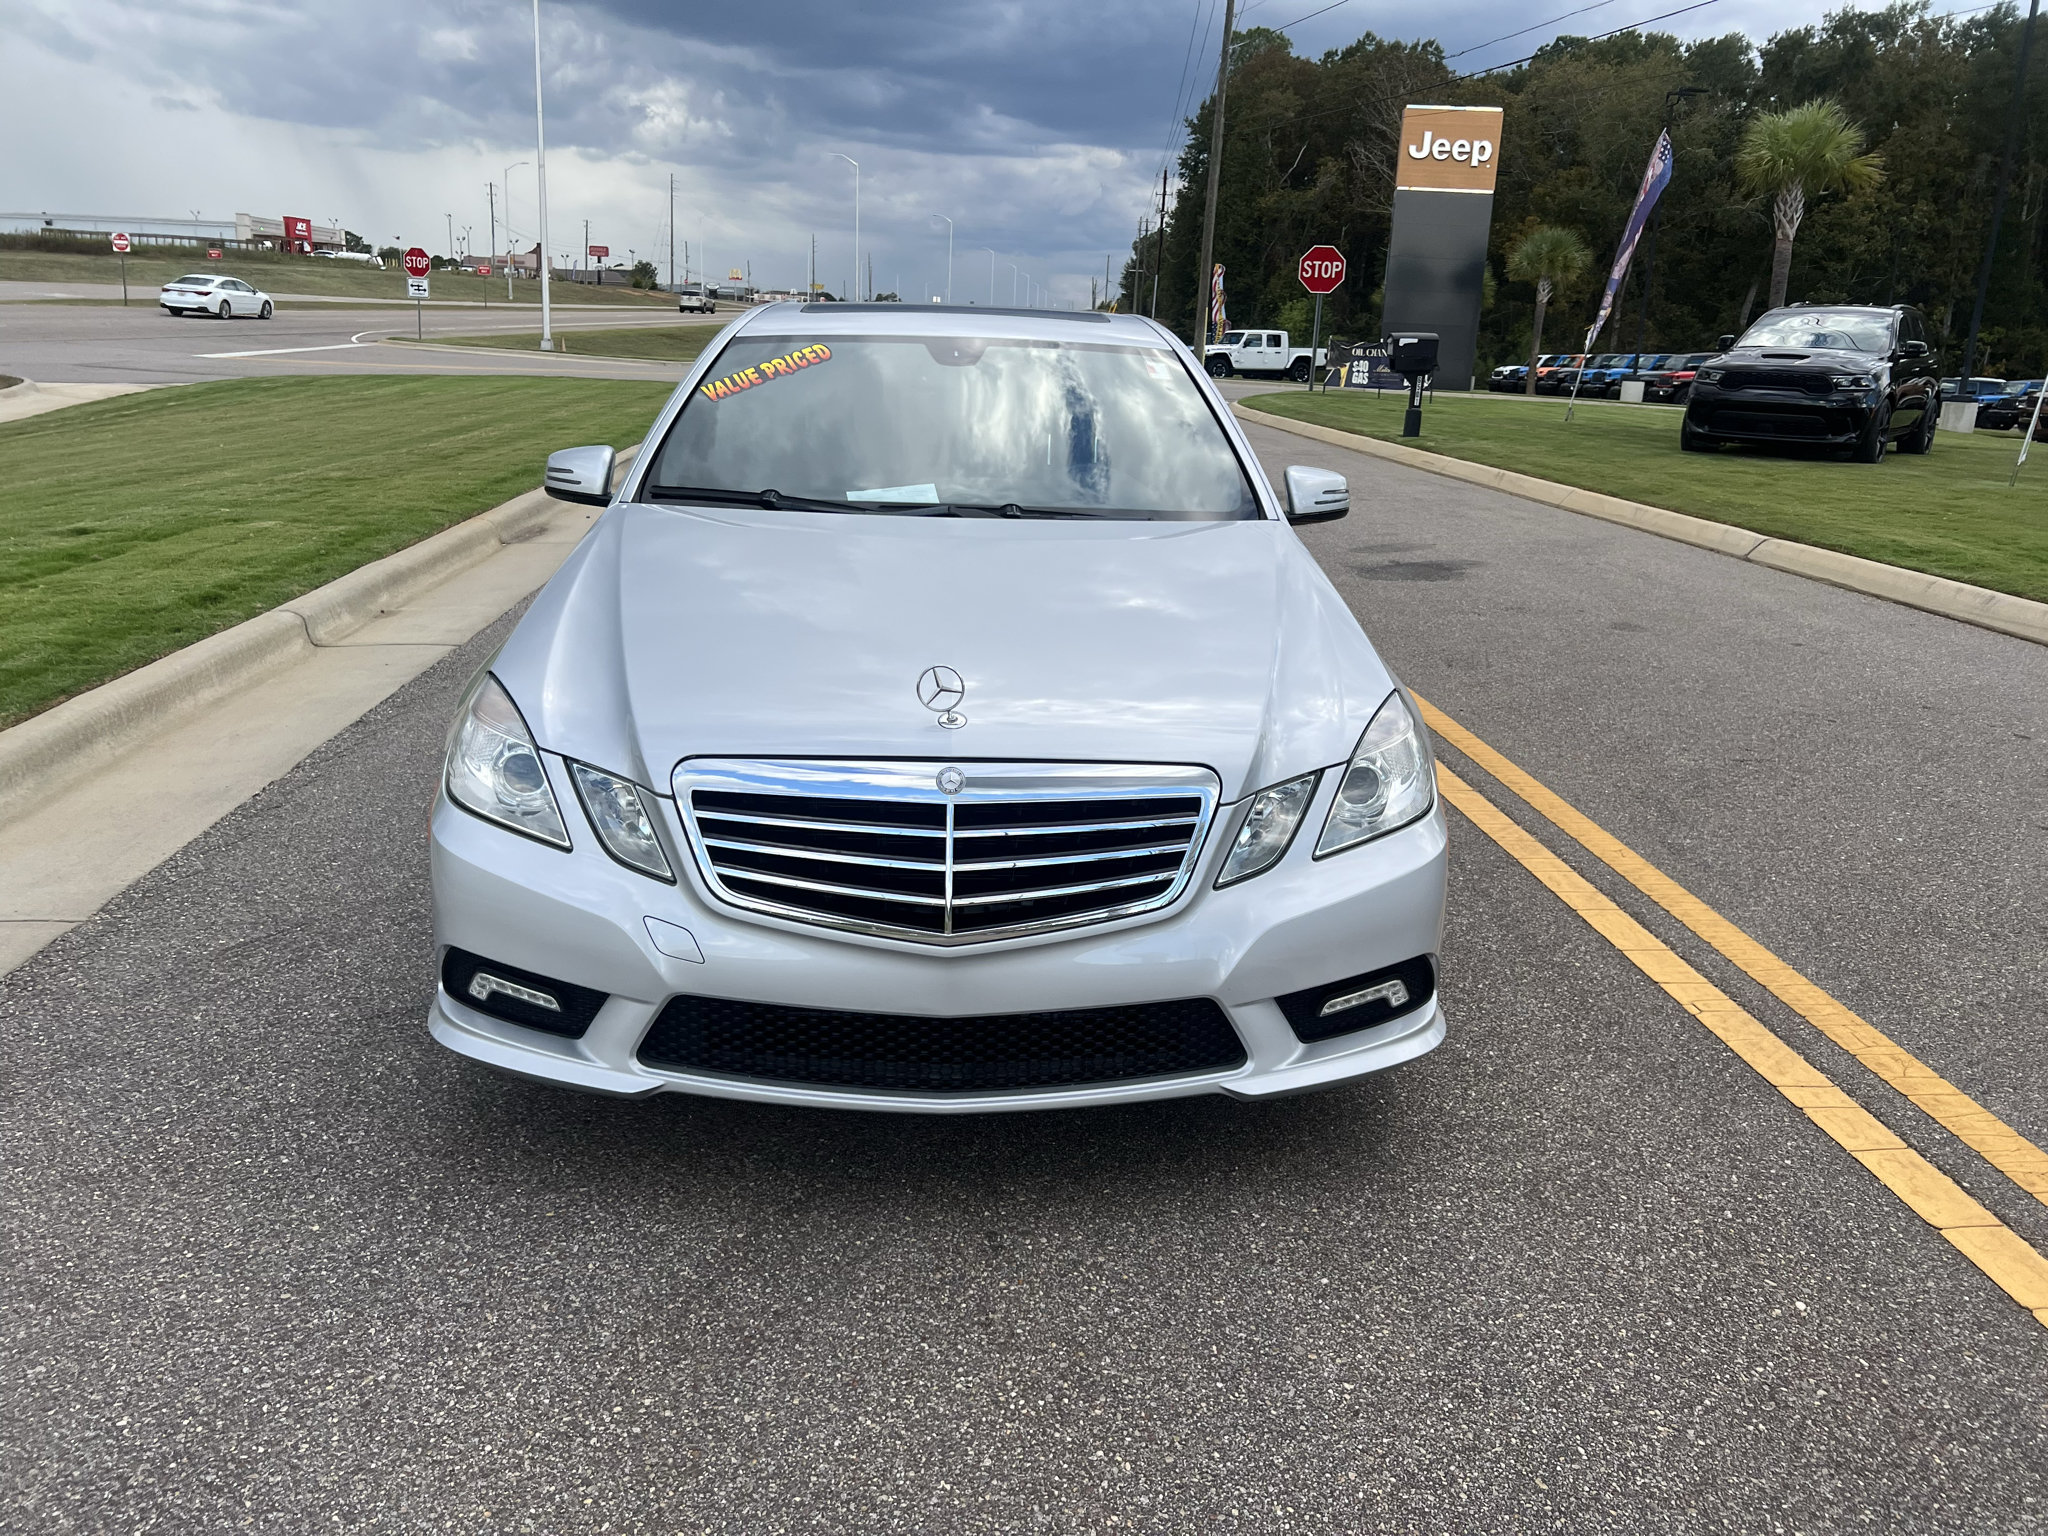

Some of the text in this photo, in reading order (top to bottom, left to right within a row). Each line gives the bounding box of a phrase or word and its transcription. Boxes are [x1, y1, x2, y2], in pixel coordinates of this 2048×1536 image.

[1408, 131, 1493, 168] Jeep
[405, 255, 429, 269] STOP
[1302, 260, 1343, 279] STOP
[1351, 348, 1388, 357] OIL CHAN
[700, 343, 832, 402] VALUE PRICED
[1352, 360, 1370, 373] $40
[1352, 372, 1370, 385] GAS
